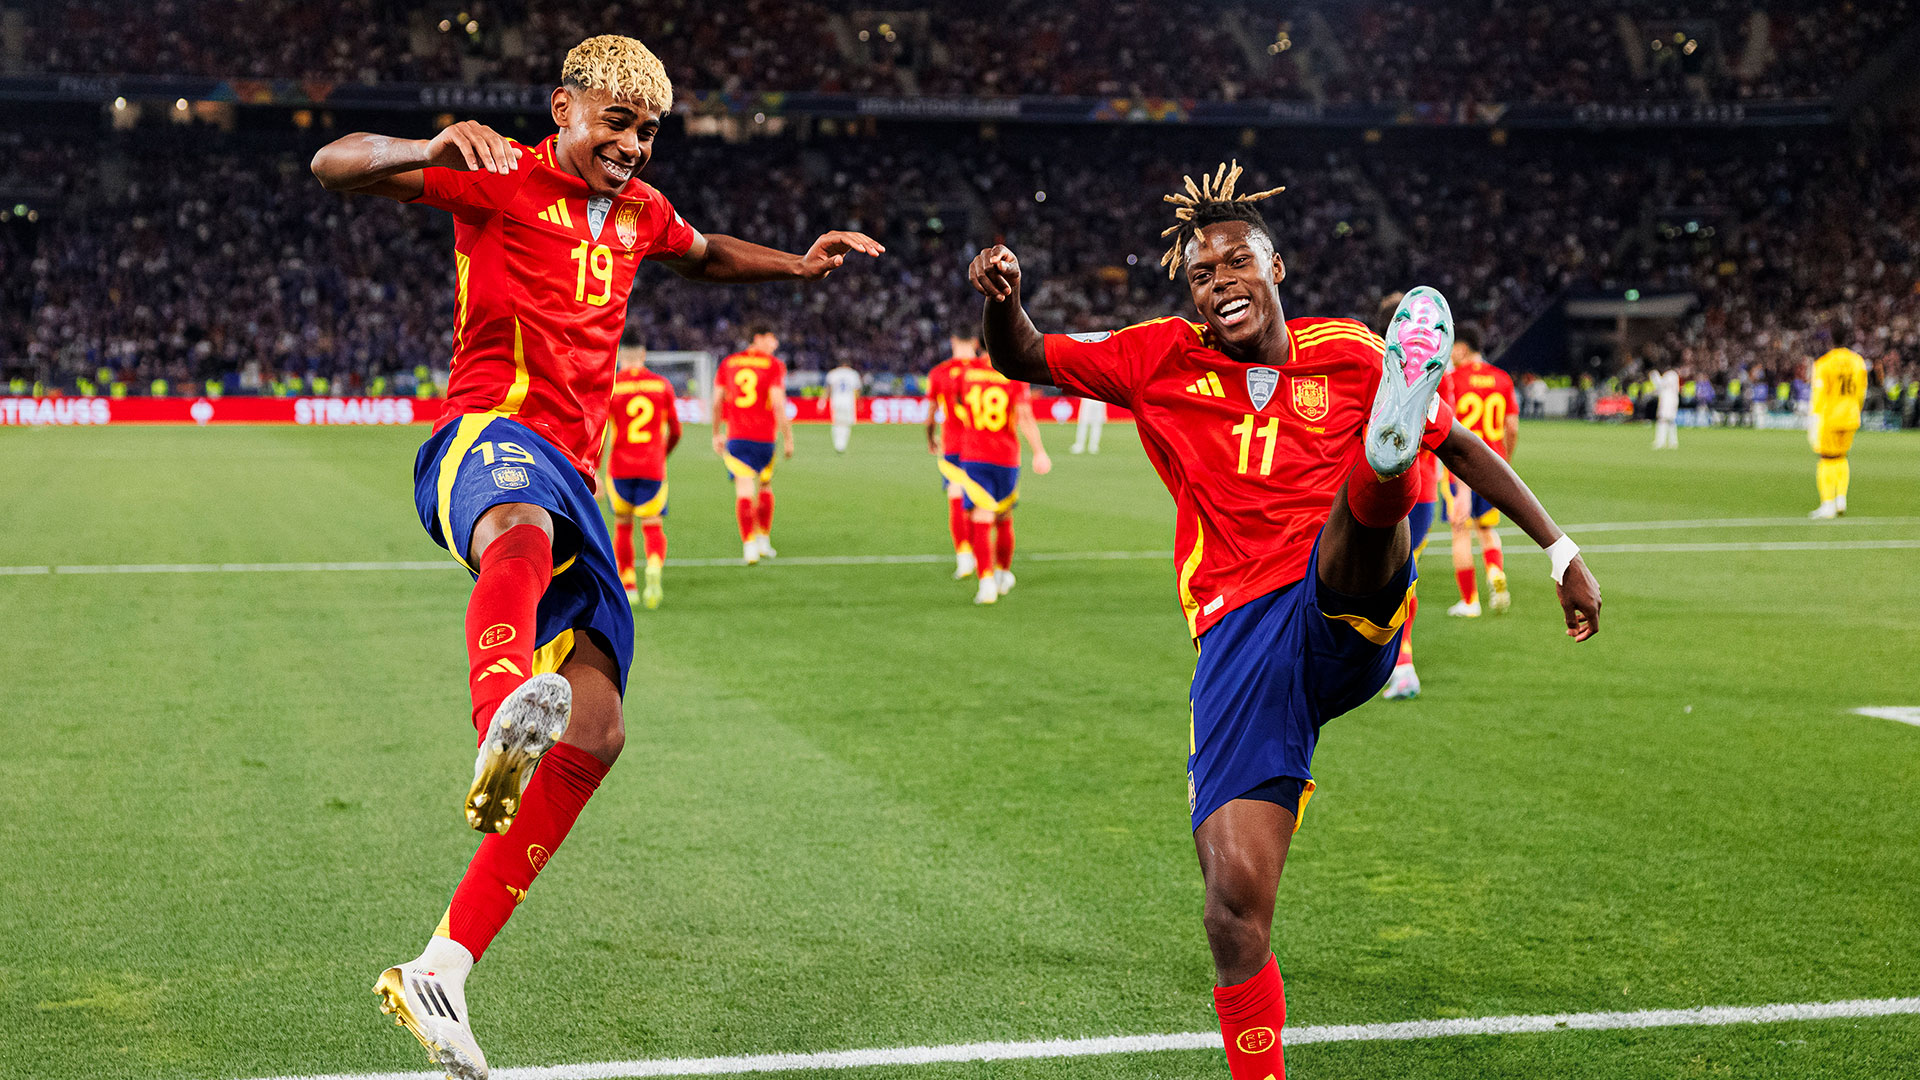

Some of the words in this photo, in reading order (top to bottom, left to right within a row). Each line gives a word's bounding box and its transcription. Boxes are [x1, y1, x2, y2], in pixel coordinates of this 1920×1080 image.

[571, 240, 613, 306] 19
[0, 398, 110, 425] TRAUSS
[295, 398, 414, 425] STRAUSS
[734, 368, 758, 409] 3
[964, 384, 1009, 432] 18
[626, 395, 655, 444] 2
[1456, 391, 1507, 442] 20
[471, 441, 536, 466] 19
[1232, 414, 1279, 475] 11
